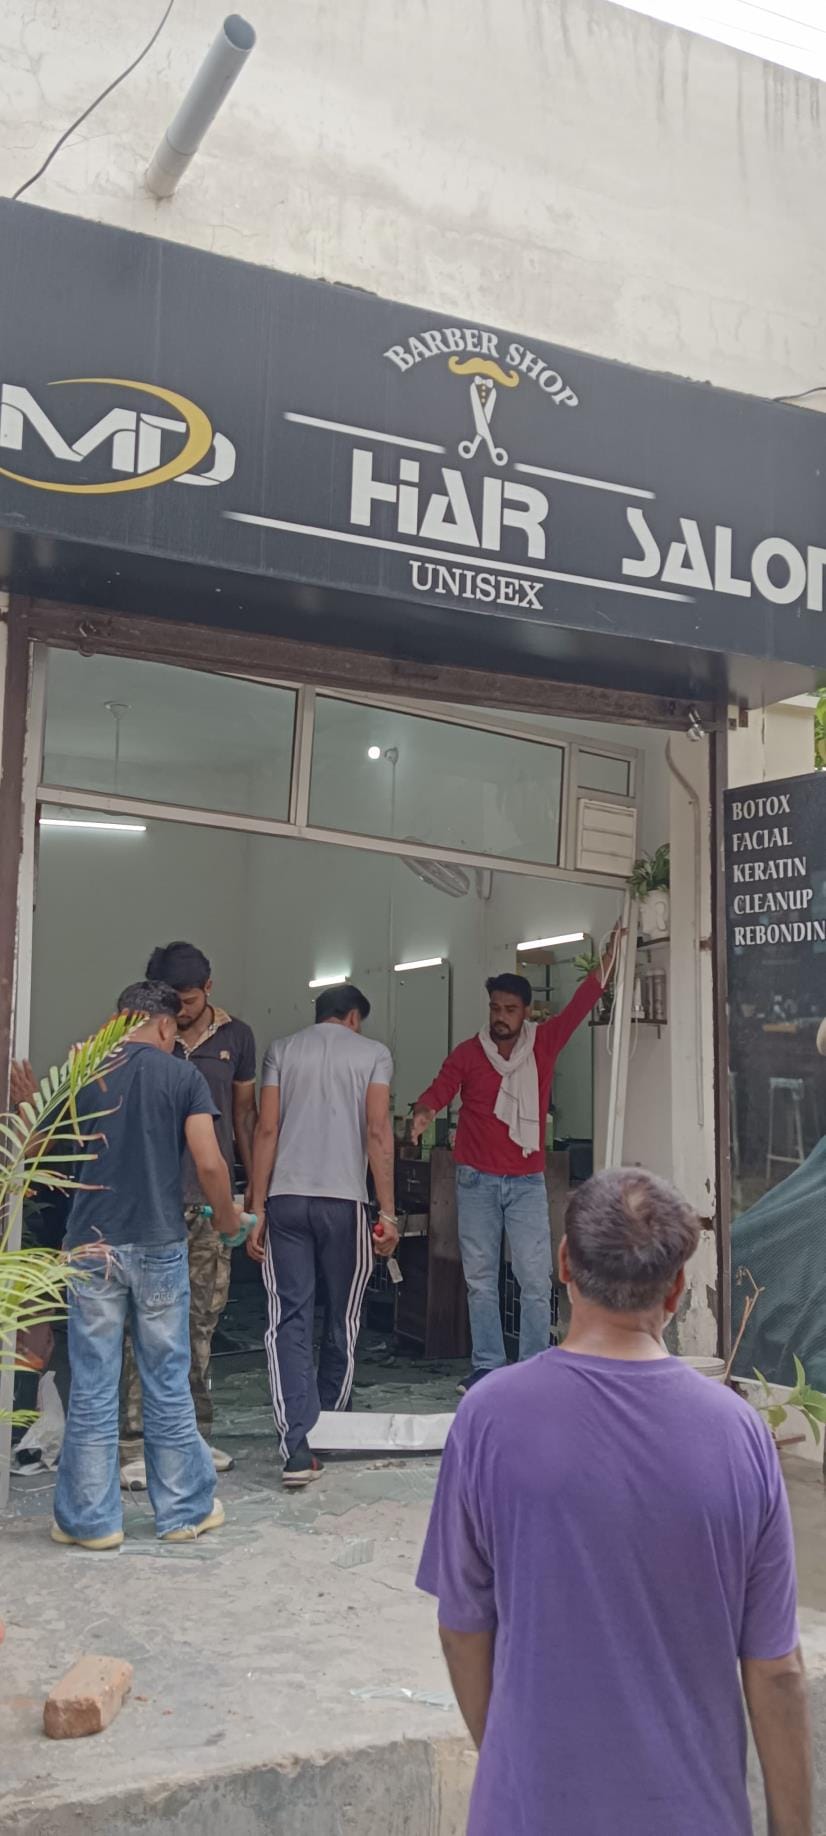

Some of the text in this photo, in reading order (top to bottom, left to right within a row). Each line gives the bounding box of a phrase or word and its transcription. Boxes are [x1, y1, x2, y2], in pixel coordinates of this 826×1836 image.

[383, 328, 579, 407] BARBER SHOP
[409, 560, 544, 610] UNISEX
[732, 794, 791, 821] BOTOX
[732, 827, 792, 852] FACIAL
[733, 856, 807, 883] KERATIN
[733, 888, 813, 914] CLEANUP
